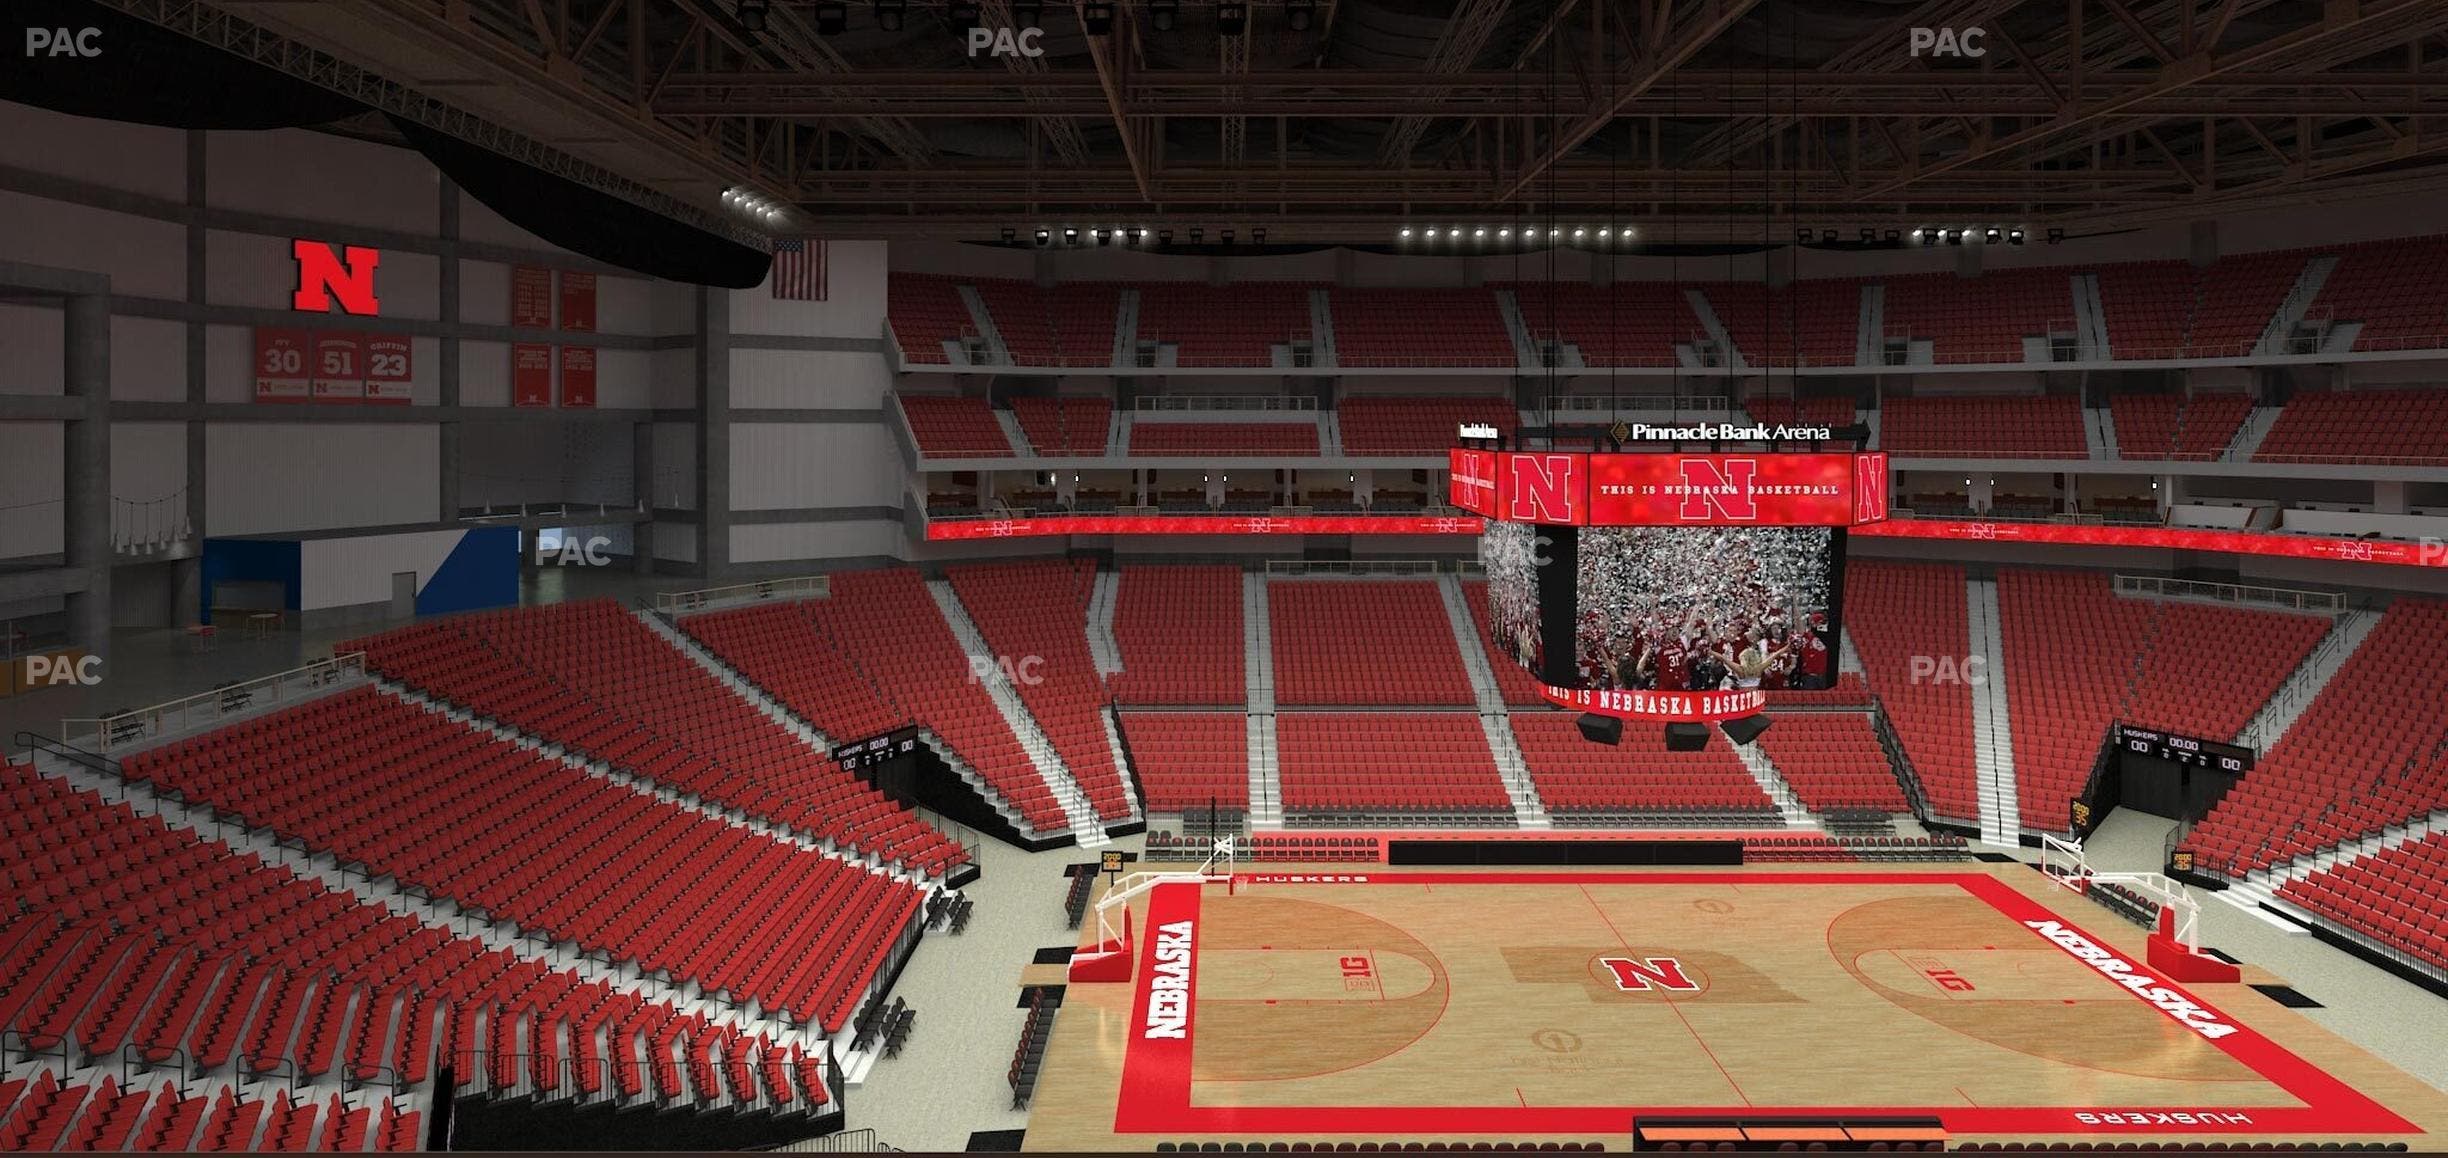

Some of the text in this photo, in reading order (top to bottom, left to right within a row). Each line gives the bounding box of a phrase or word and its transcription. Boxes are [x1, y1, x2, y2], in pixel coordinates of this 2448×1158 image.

[292, 238, 379, 317] N
[264, 349, 300, 374] 30
[323, 351, 352, 375] 51
[371, 354, 407, 376] 23
[1632, 422, 1831, 440] Pinnacle Bank Arena
[1512, 455, 1571, 522] N
[1601, 485, 1839, 495] THIS IS NEBRASKA BASKETBALL
[1680, 459, 1756, 520] N
[1858, 455, 1882, 522] N
[1577, 689, 1591, 705] IS
[1600, 690, 1692, 715] NEBRASKA
[1144, 920, 1193, 1039] NEBRASKA
[1600, 957, 1700, 991] N
[2023, 920, 2239, 1039] NEBRASKA
[2074, 1112, 2253, 1125] HUSKERS
